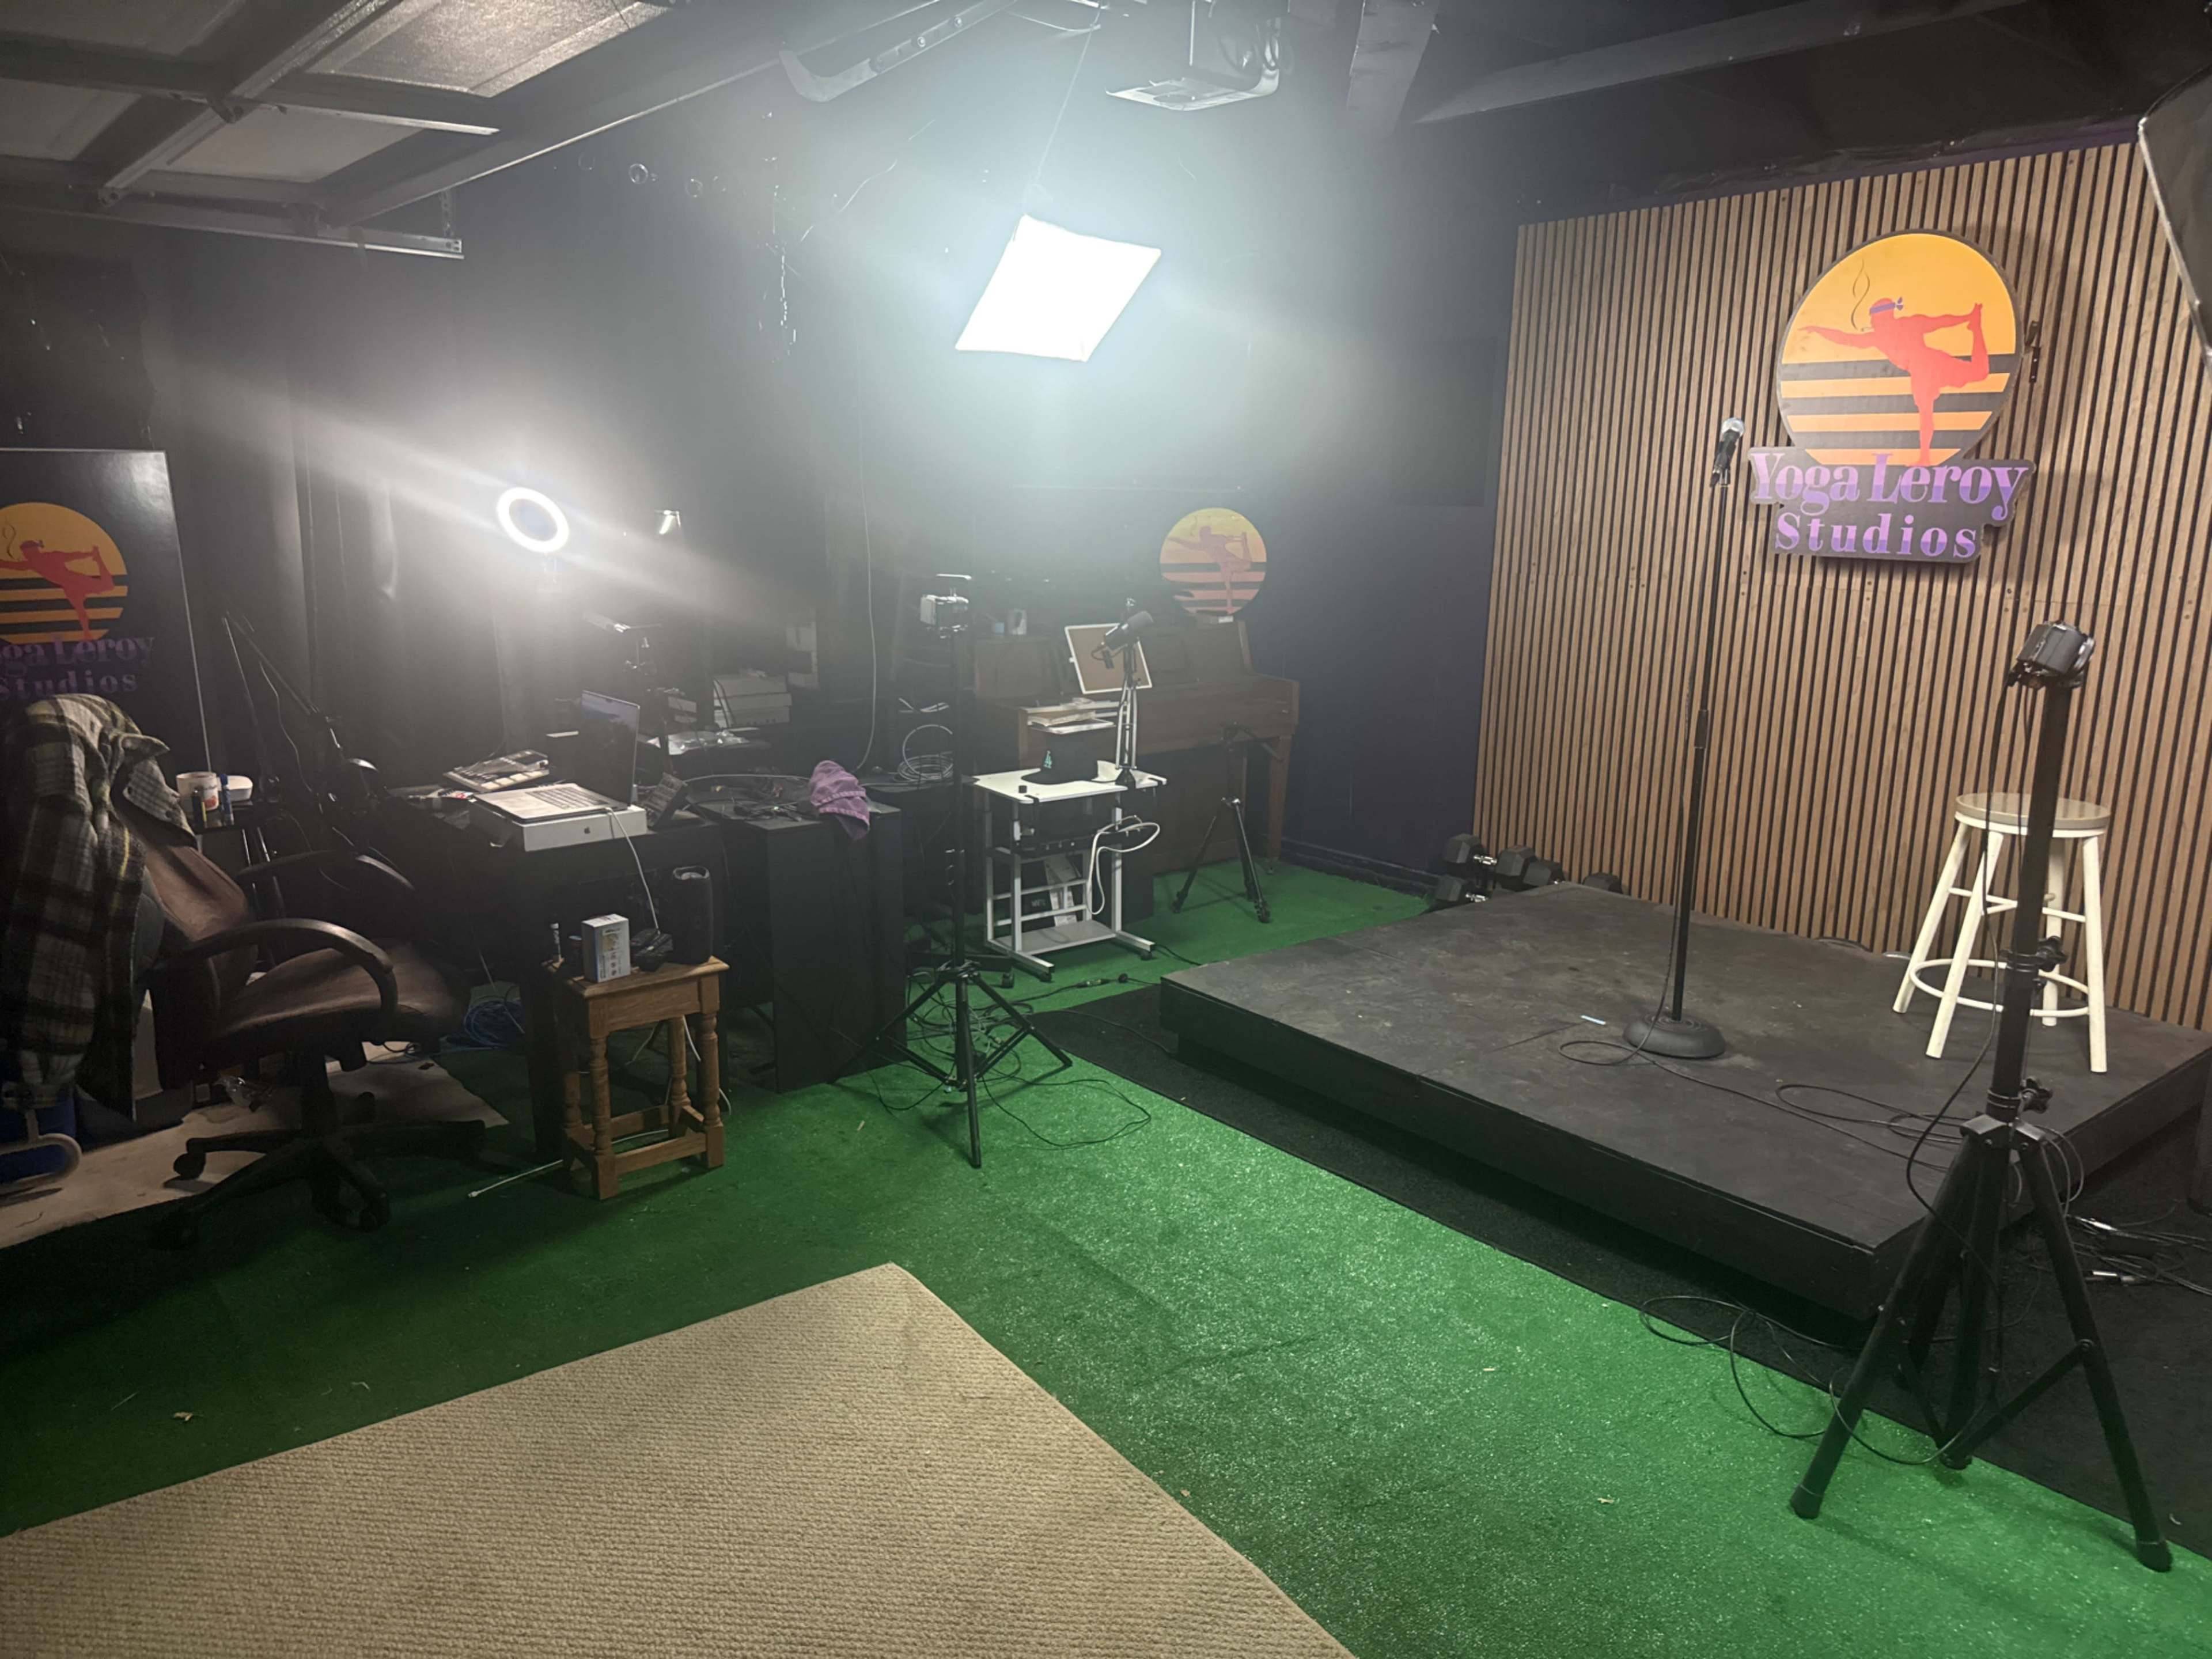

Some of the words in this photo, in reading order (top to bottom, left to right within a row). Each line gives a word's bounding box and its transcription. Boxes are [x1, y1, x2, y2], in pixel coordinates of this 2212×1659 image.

[1750, 452, 1861, 516] Yoga
[1866, 453, 2029, 521] Leroy
[1775, 512, 1976, 558] Studios
[51, 633, 156, 667] Leroy
